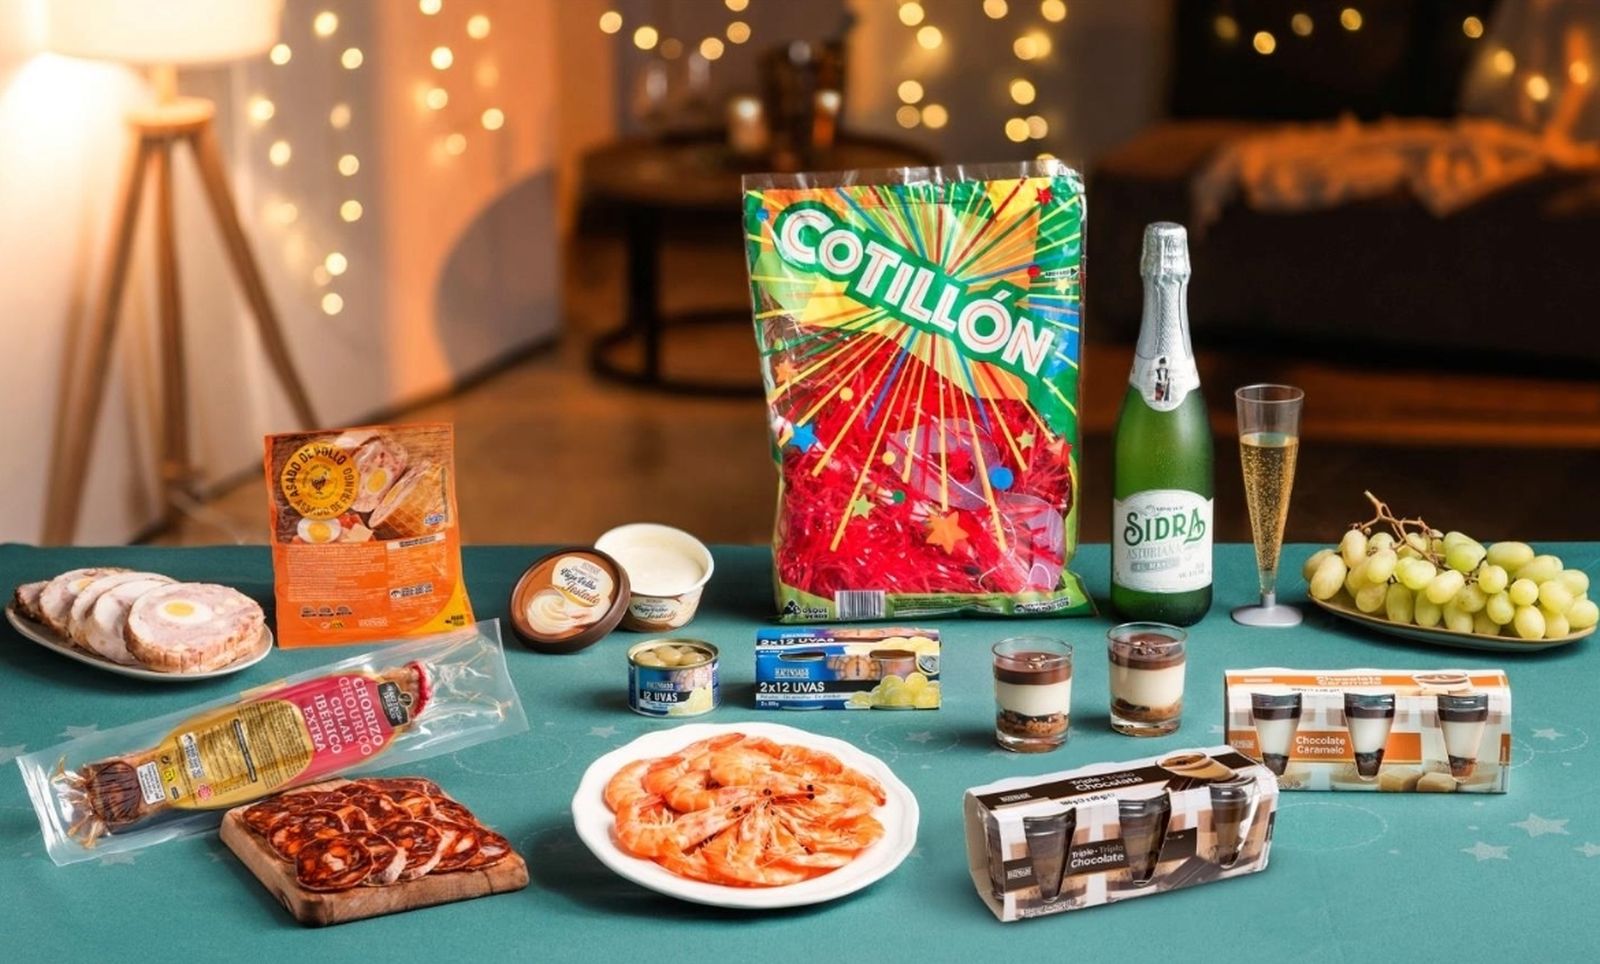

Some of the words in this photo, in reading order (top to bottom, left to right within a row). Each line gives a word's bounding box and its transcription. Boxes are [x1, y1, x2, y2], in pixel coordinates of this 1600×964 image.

[780, 208, 1055, 376] COTILLÓN
[285, 461, 302, 498] ASADO
[299, 448, 314, 463] DE
[313, 446, 347, 465] POLLO
[1124, 507, 1206, 546] SIDRA
[654, 692, 678, 702] UVAS
[760, 682, 790, 693] 2x12
[793, 682, 825, 693] UVAS
[314, 694, 342, 754] IBÉRICO
[330, 697, 354, 744] CULAR
[353, 677, 384, 746] CHORIZO
[304, 705, 326, 752] EXTRA
[1295, 736, 1346, 745] Chocolate
[1296, 745, 1345, 755] Caramelo
[1075, 776, 1144, 791] Chocolate
[1071, 853, 1124, 868] Chocolate
[1072, 848, 1094, 859] Triple
